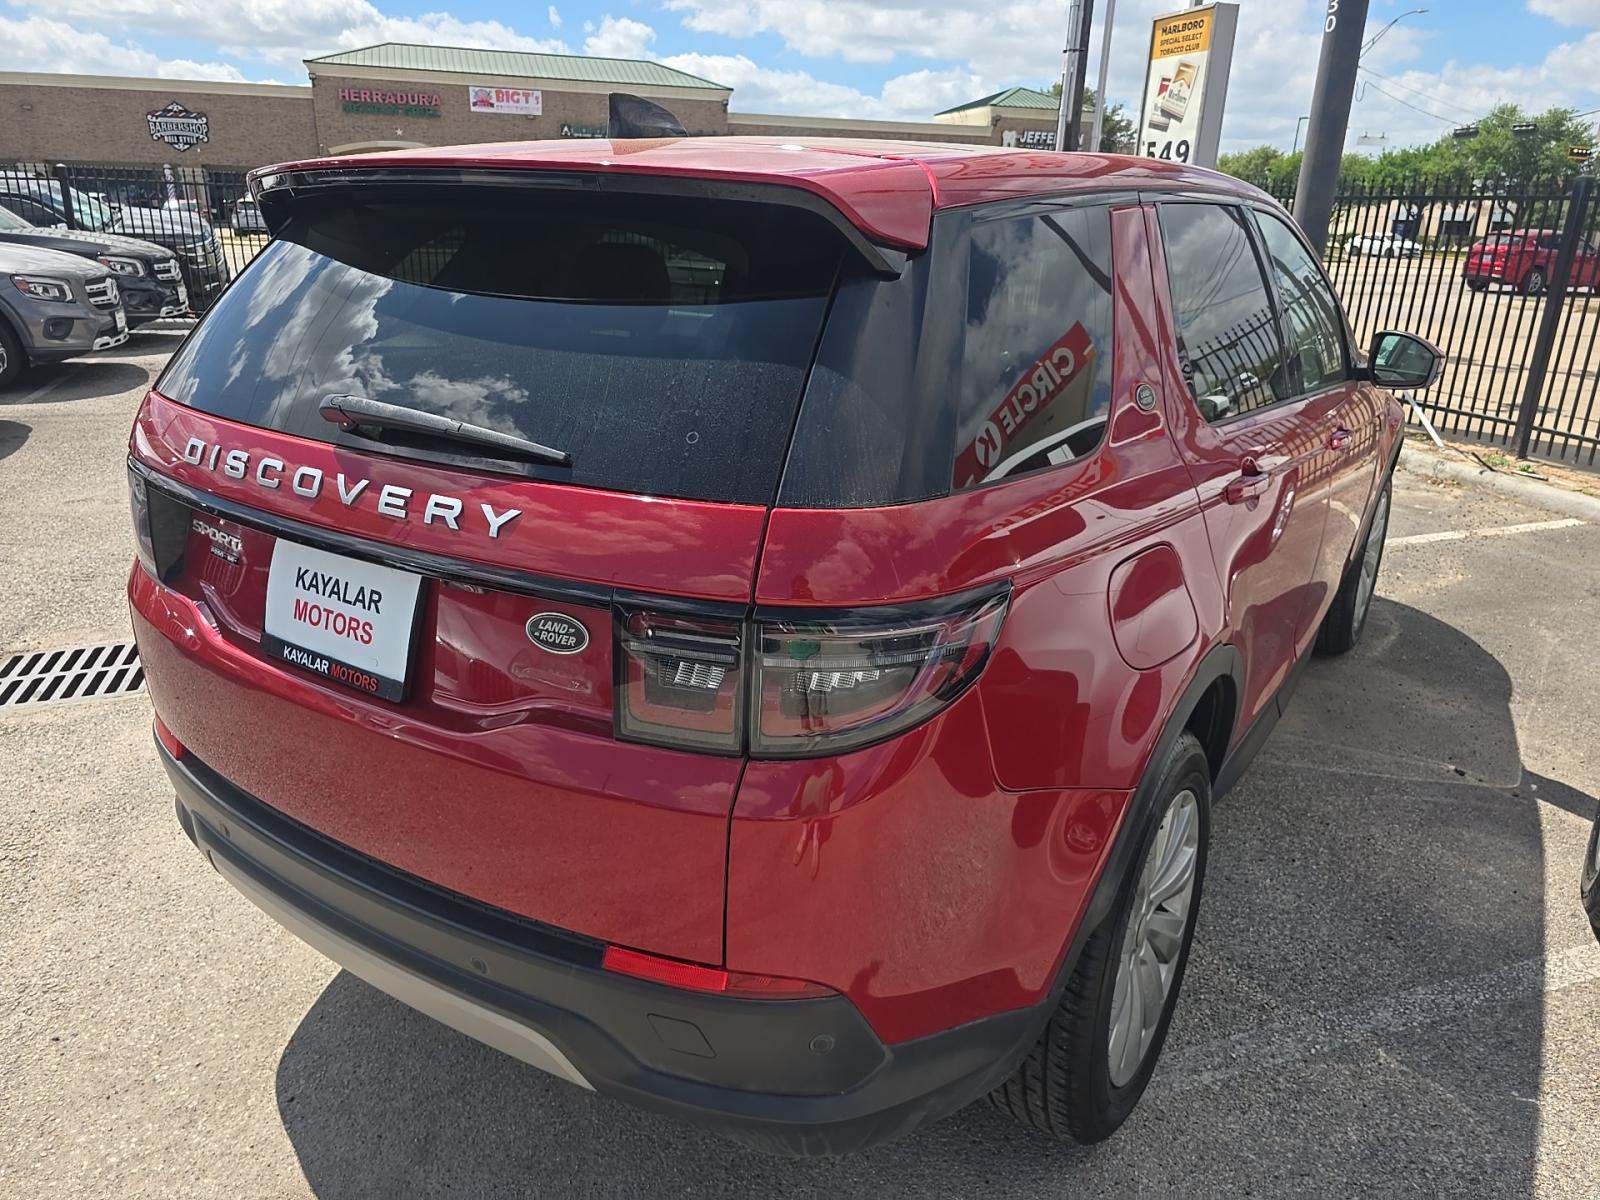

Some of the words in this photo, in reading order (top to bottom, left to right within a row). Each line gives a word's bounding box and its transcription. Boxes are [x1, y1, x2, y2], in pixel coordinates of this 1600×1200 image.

[1159, 37, 1181, 47] SPECIAL
[1182, 32, 1203, 42] SELECT
[1161, 19, 1205, 36] MARLBORO
[1159, 45, 1185, 56] TOBACCO
[1185, 42, 1200, 52] CLUB
[338, 89, 441, 107] HERRADURA
[149, 121, 208, 136] BARBERSHOP
[183, 436, 523, 540] DISCOVERY
[193, 518, 242, 553] SPORT
[295, 566, 384, 616] KAYALAR
[293, 598, 376, 646] MOTORS
[283, 645, 330, 675] KAYALAR
[330, 663, 379, 693] MOTORS
